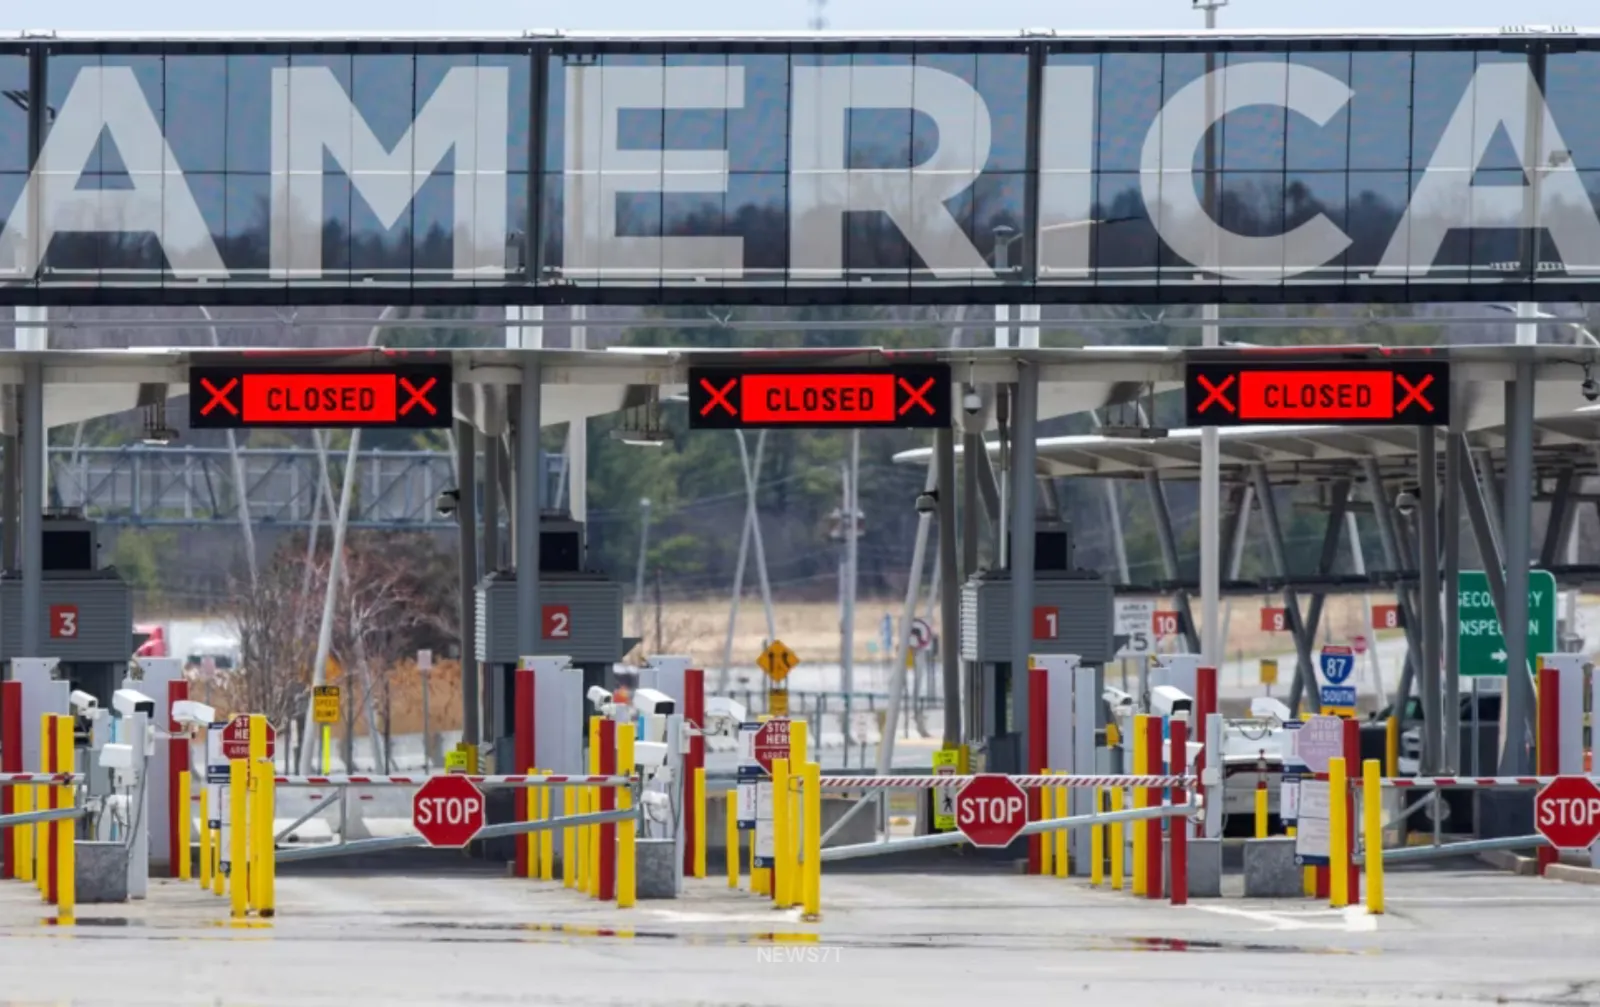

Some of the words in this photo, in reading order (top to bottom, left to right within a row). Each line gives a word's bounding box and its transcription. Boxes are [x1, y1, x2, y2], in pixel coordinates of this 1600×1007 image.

[0, 62, 1600, 280] AMERICA
[266, 387, 375, 412] CLOSED
[766, 387, 874, 412] CLOSED
[1263, 384, 1371, 408] CLOSED
[60, 612, 76, 637] 3
[551, 612, 568, 637] 2
[1046, 613, 1056, 637] 1
[1157, 616, 1177, 633] 10
[1273, 613, 1284, 630] 9
[1386, 610, 1396, 627] 8
[1326, 658, 1346, 677] 87
[1323, 691, 1354, 702] SOUTH
[234, 729, 250, 740] HE
[766, 722, 791, 733] STO
[766, 734, 791, 744] HER
[418, 797, 480, 824] STOP
[961, 796, 1023, 824] STOP
[1540, 798, 1600, 826] STOP
